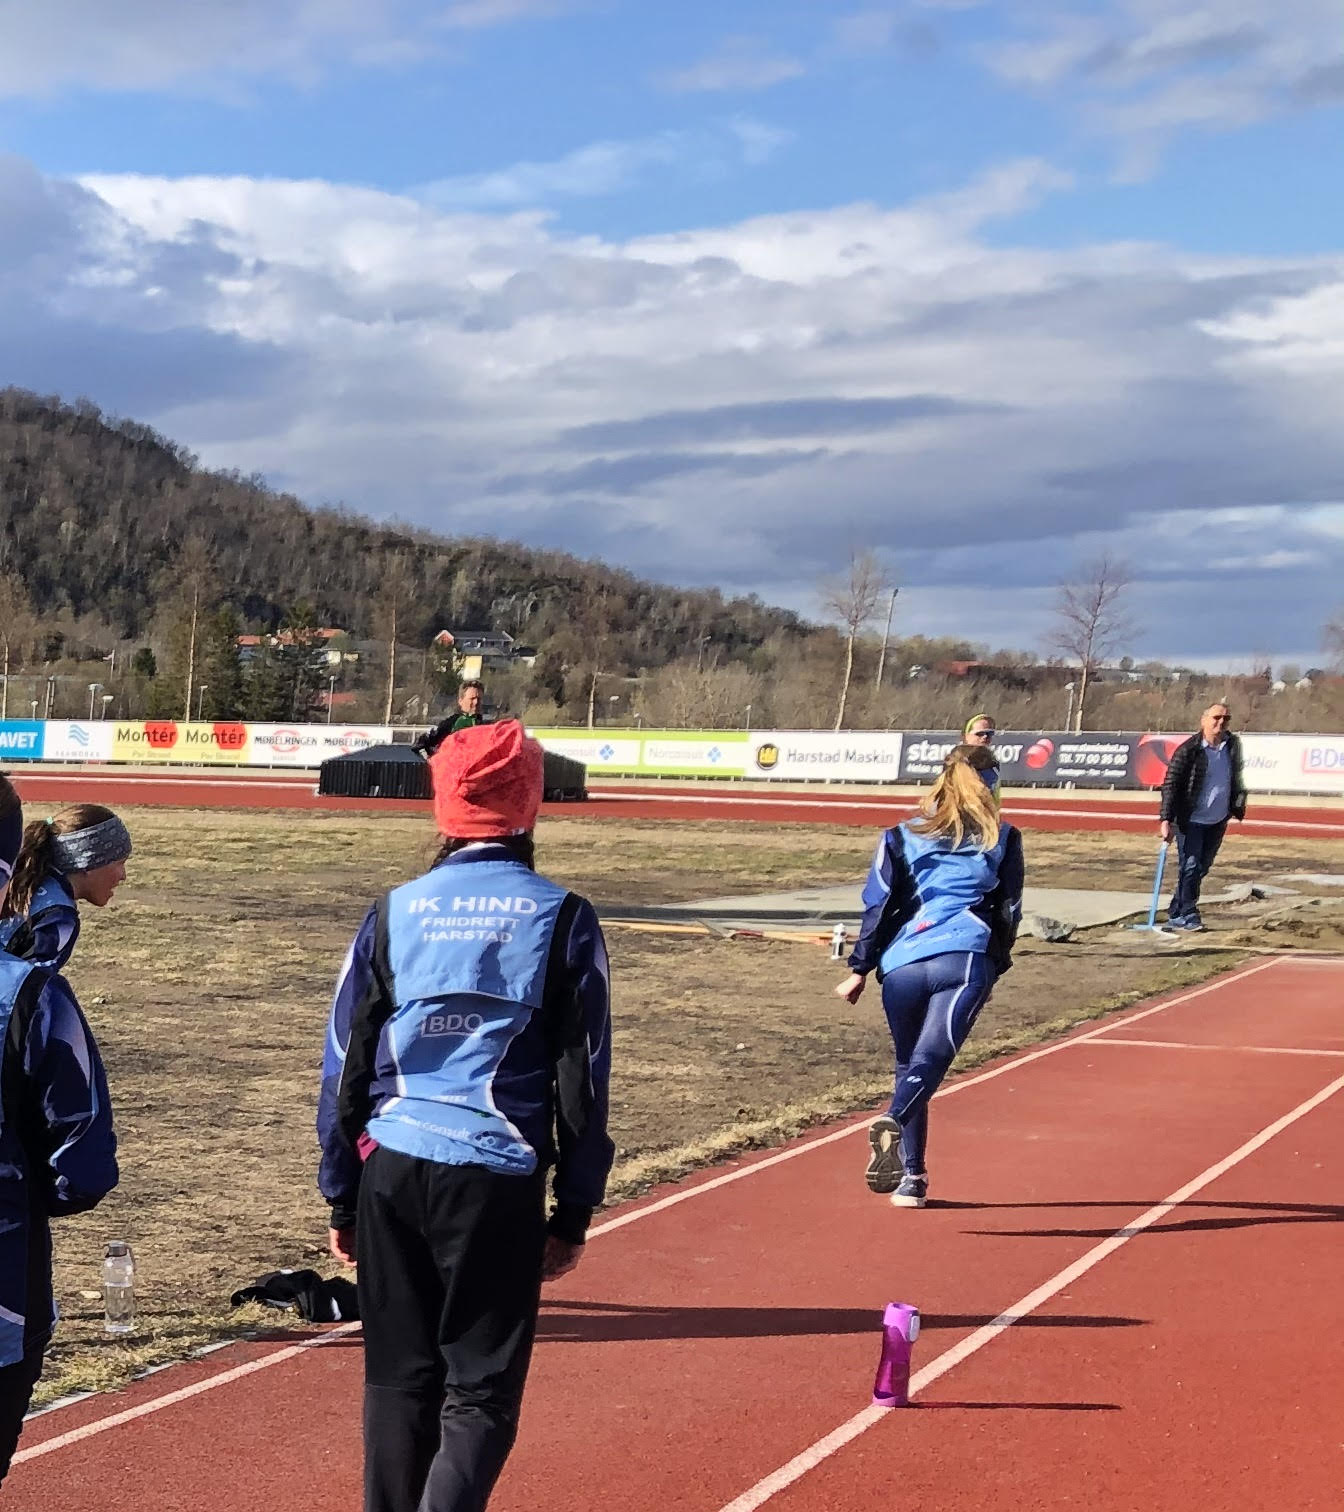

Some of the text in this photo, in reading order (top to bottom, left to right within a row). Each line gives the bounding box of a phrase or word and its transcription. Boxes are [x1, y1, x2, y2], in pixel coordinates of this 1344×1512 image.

[117, 728, 176, 743] Montér
[186, 728, 245, 744] Montér
[254, 735, 317, 746] MØBELRINGEN
[786, 749, 894, 764] Harstad Maskin
[1074, 753, 1086, 764] 77
[1242, 756, 1279, 769] diNor
[1311, 748, 1344, 768] BD
[408, 896, 538, 915] IK HIND
[422, 916, 520, 929] FRIIDRETT
[423, 930, 513, 943] HARSTAD
[429, 1013, 484, 1032] BDO
